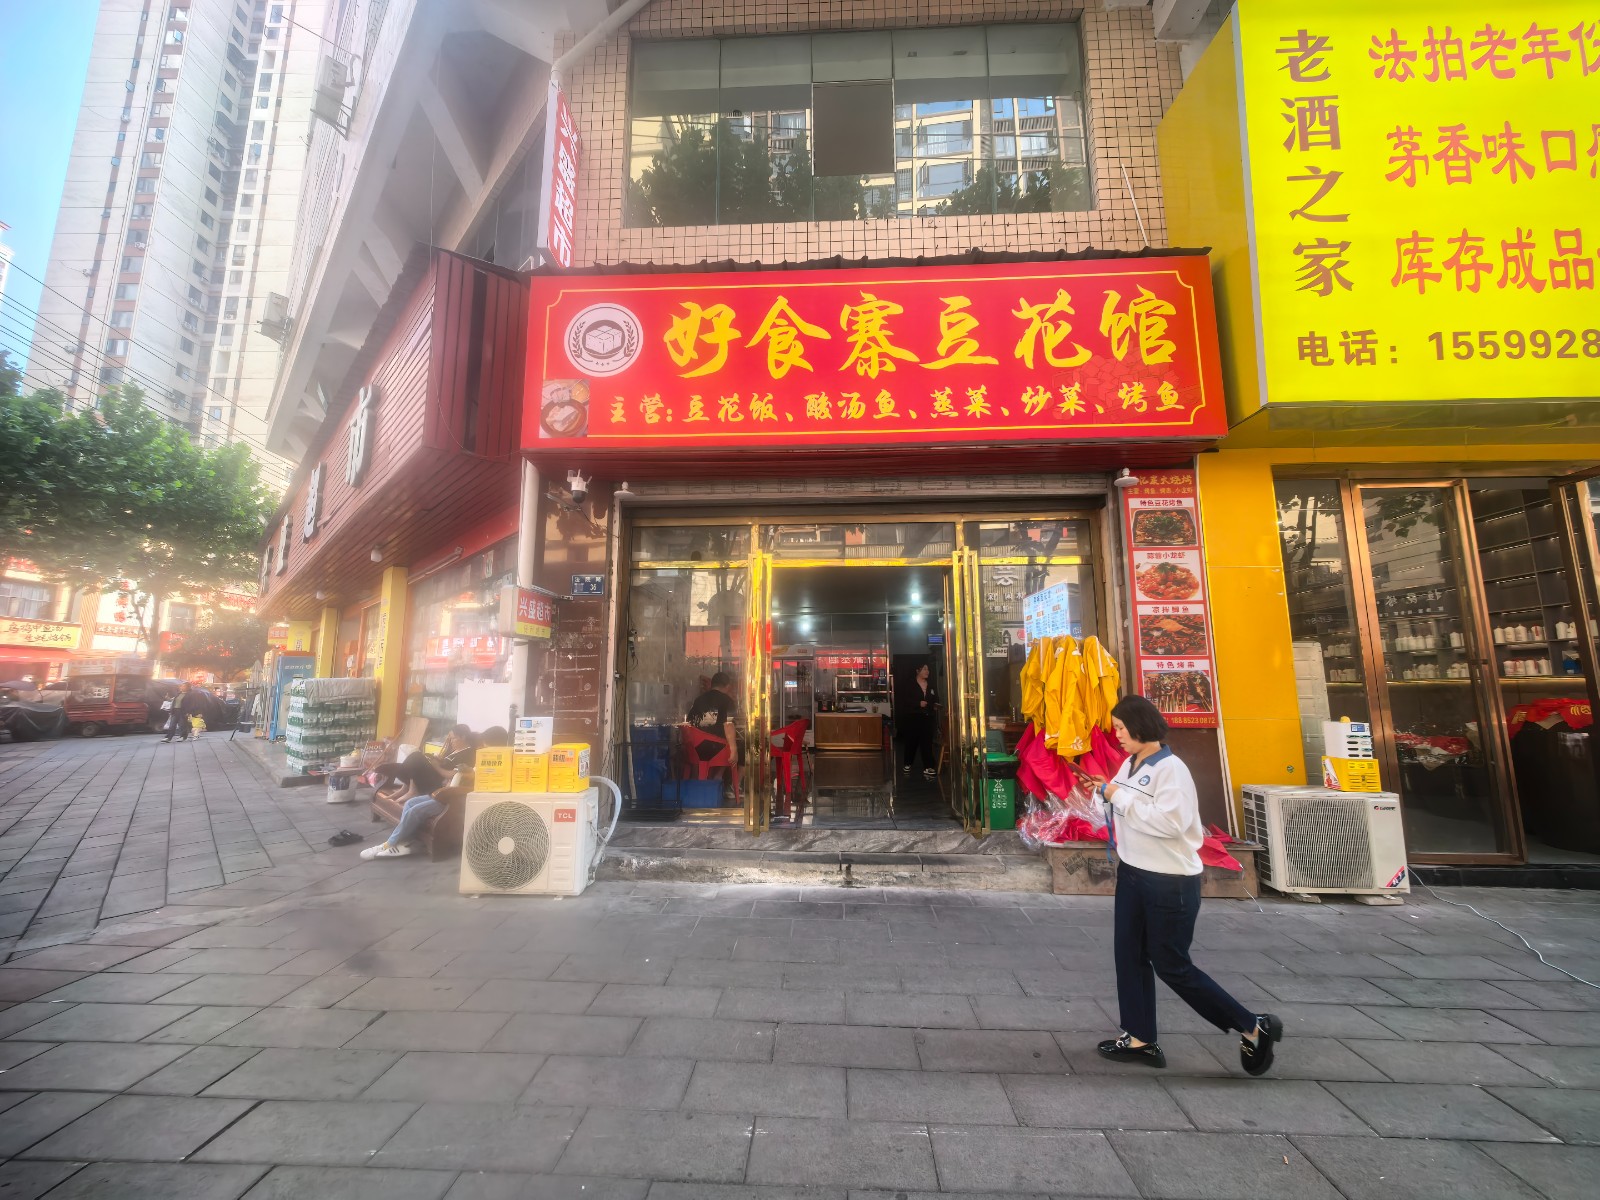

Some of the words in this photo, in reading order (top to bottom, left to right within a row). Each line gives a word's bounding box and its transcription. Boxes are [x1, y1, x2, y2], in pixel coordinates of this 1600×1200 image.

[1274, 28, 1355, 297] 老酒之家
[1390, 226, 1600, 296] 库存成品
[662, 283, 1178, 381] 好食寨豆花馆
[1297, 329, 1399, 366] 电话：
[1427, 328, 1600, 361] 1559928
[519, 596, 552, 622] 兴盛超市
